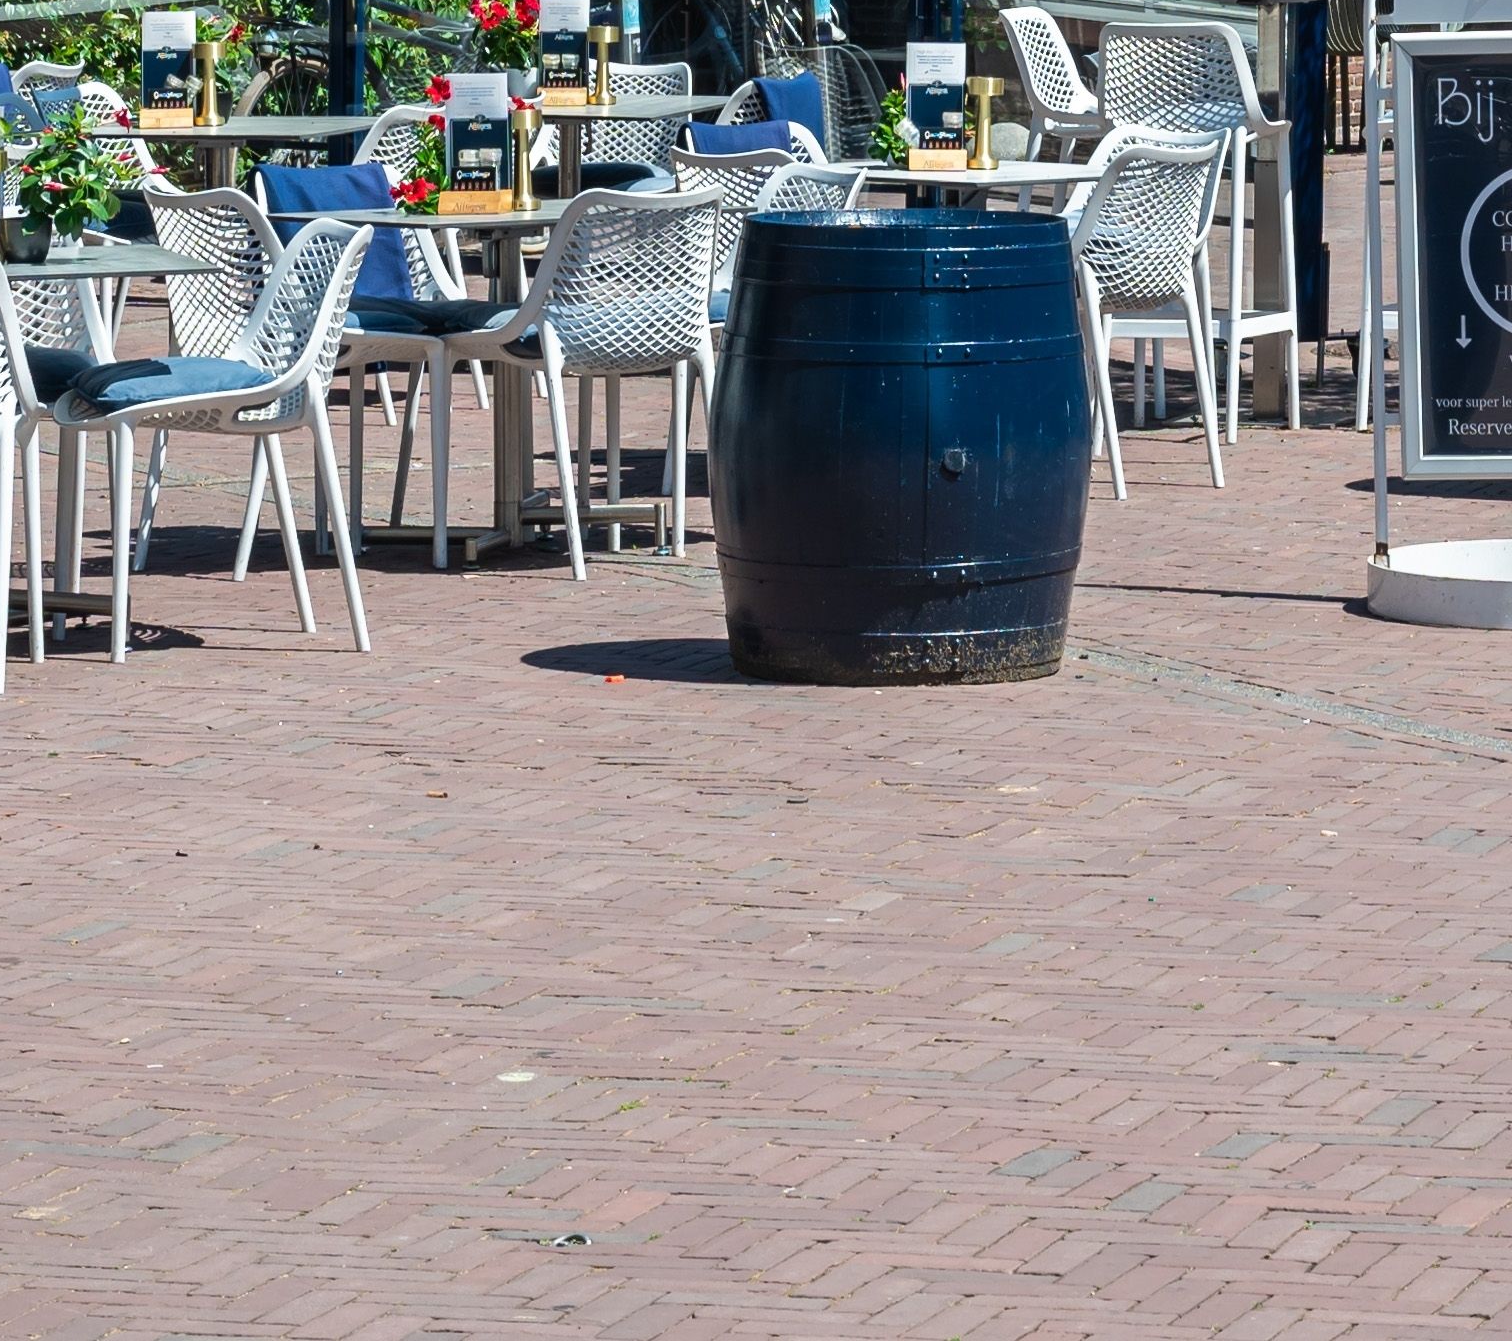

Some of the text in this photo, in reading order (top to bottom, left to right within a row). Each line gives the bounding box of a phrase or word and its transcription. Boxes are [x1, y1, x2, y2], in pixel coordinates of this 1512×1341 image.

[1437, 77, 1494, 143] Bij
[1435, 398, 1463, 408] voor
[1465, 398, 1500, 411] super
